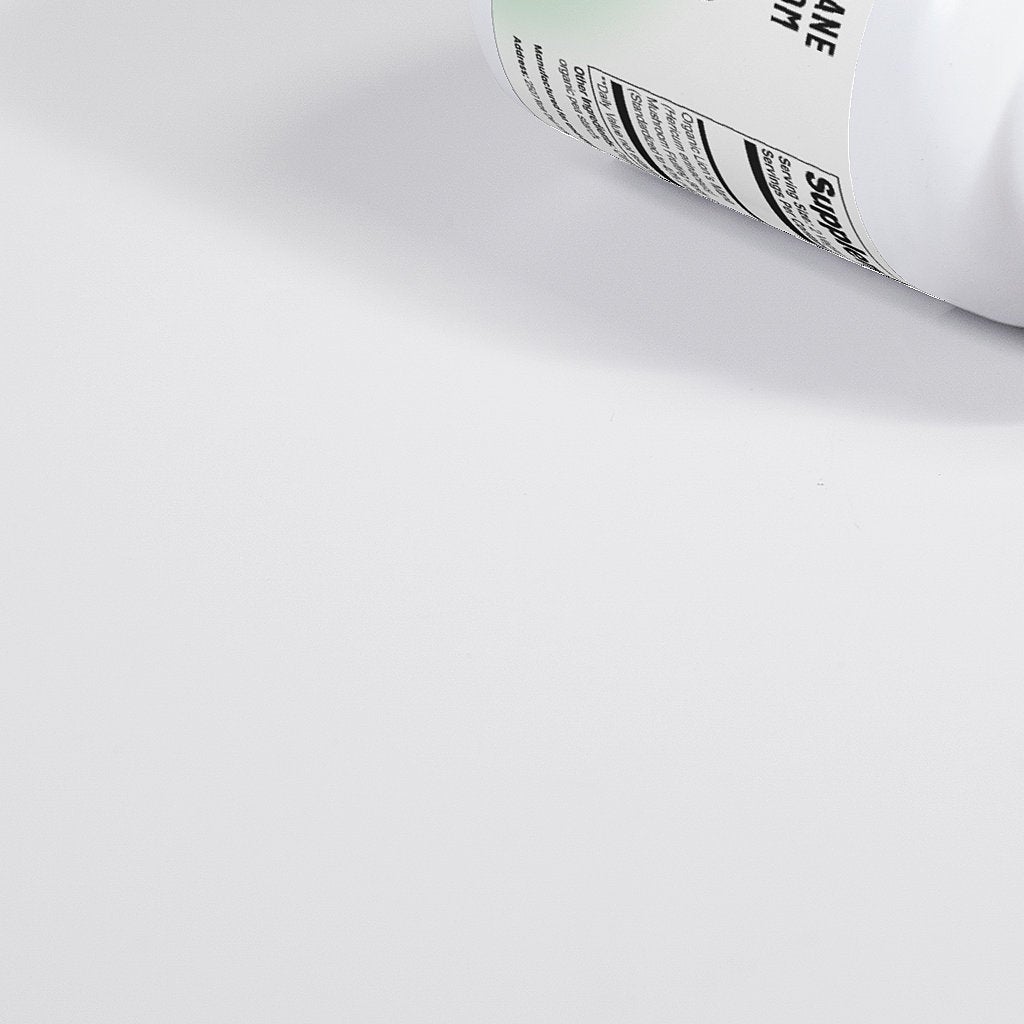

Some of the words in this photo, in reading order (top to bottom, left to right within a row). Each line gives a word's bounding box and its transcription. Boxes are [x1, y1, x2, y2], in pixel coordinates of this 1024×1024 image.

[513, 35, 530, 80] Address:
[533, 43, 563, 112] Manufactured
[558, 58, 576, 96] organic
[573, 66, 588, 97] Other
[646, 96, 669, 151] Mushroom
[681, 111, 702, 155] Organic
[761, 148, 785, 199] Servings
[778, 155, 799, 201] Serving
